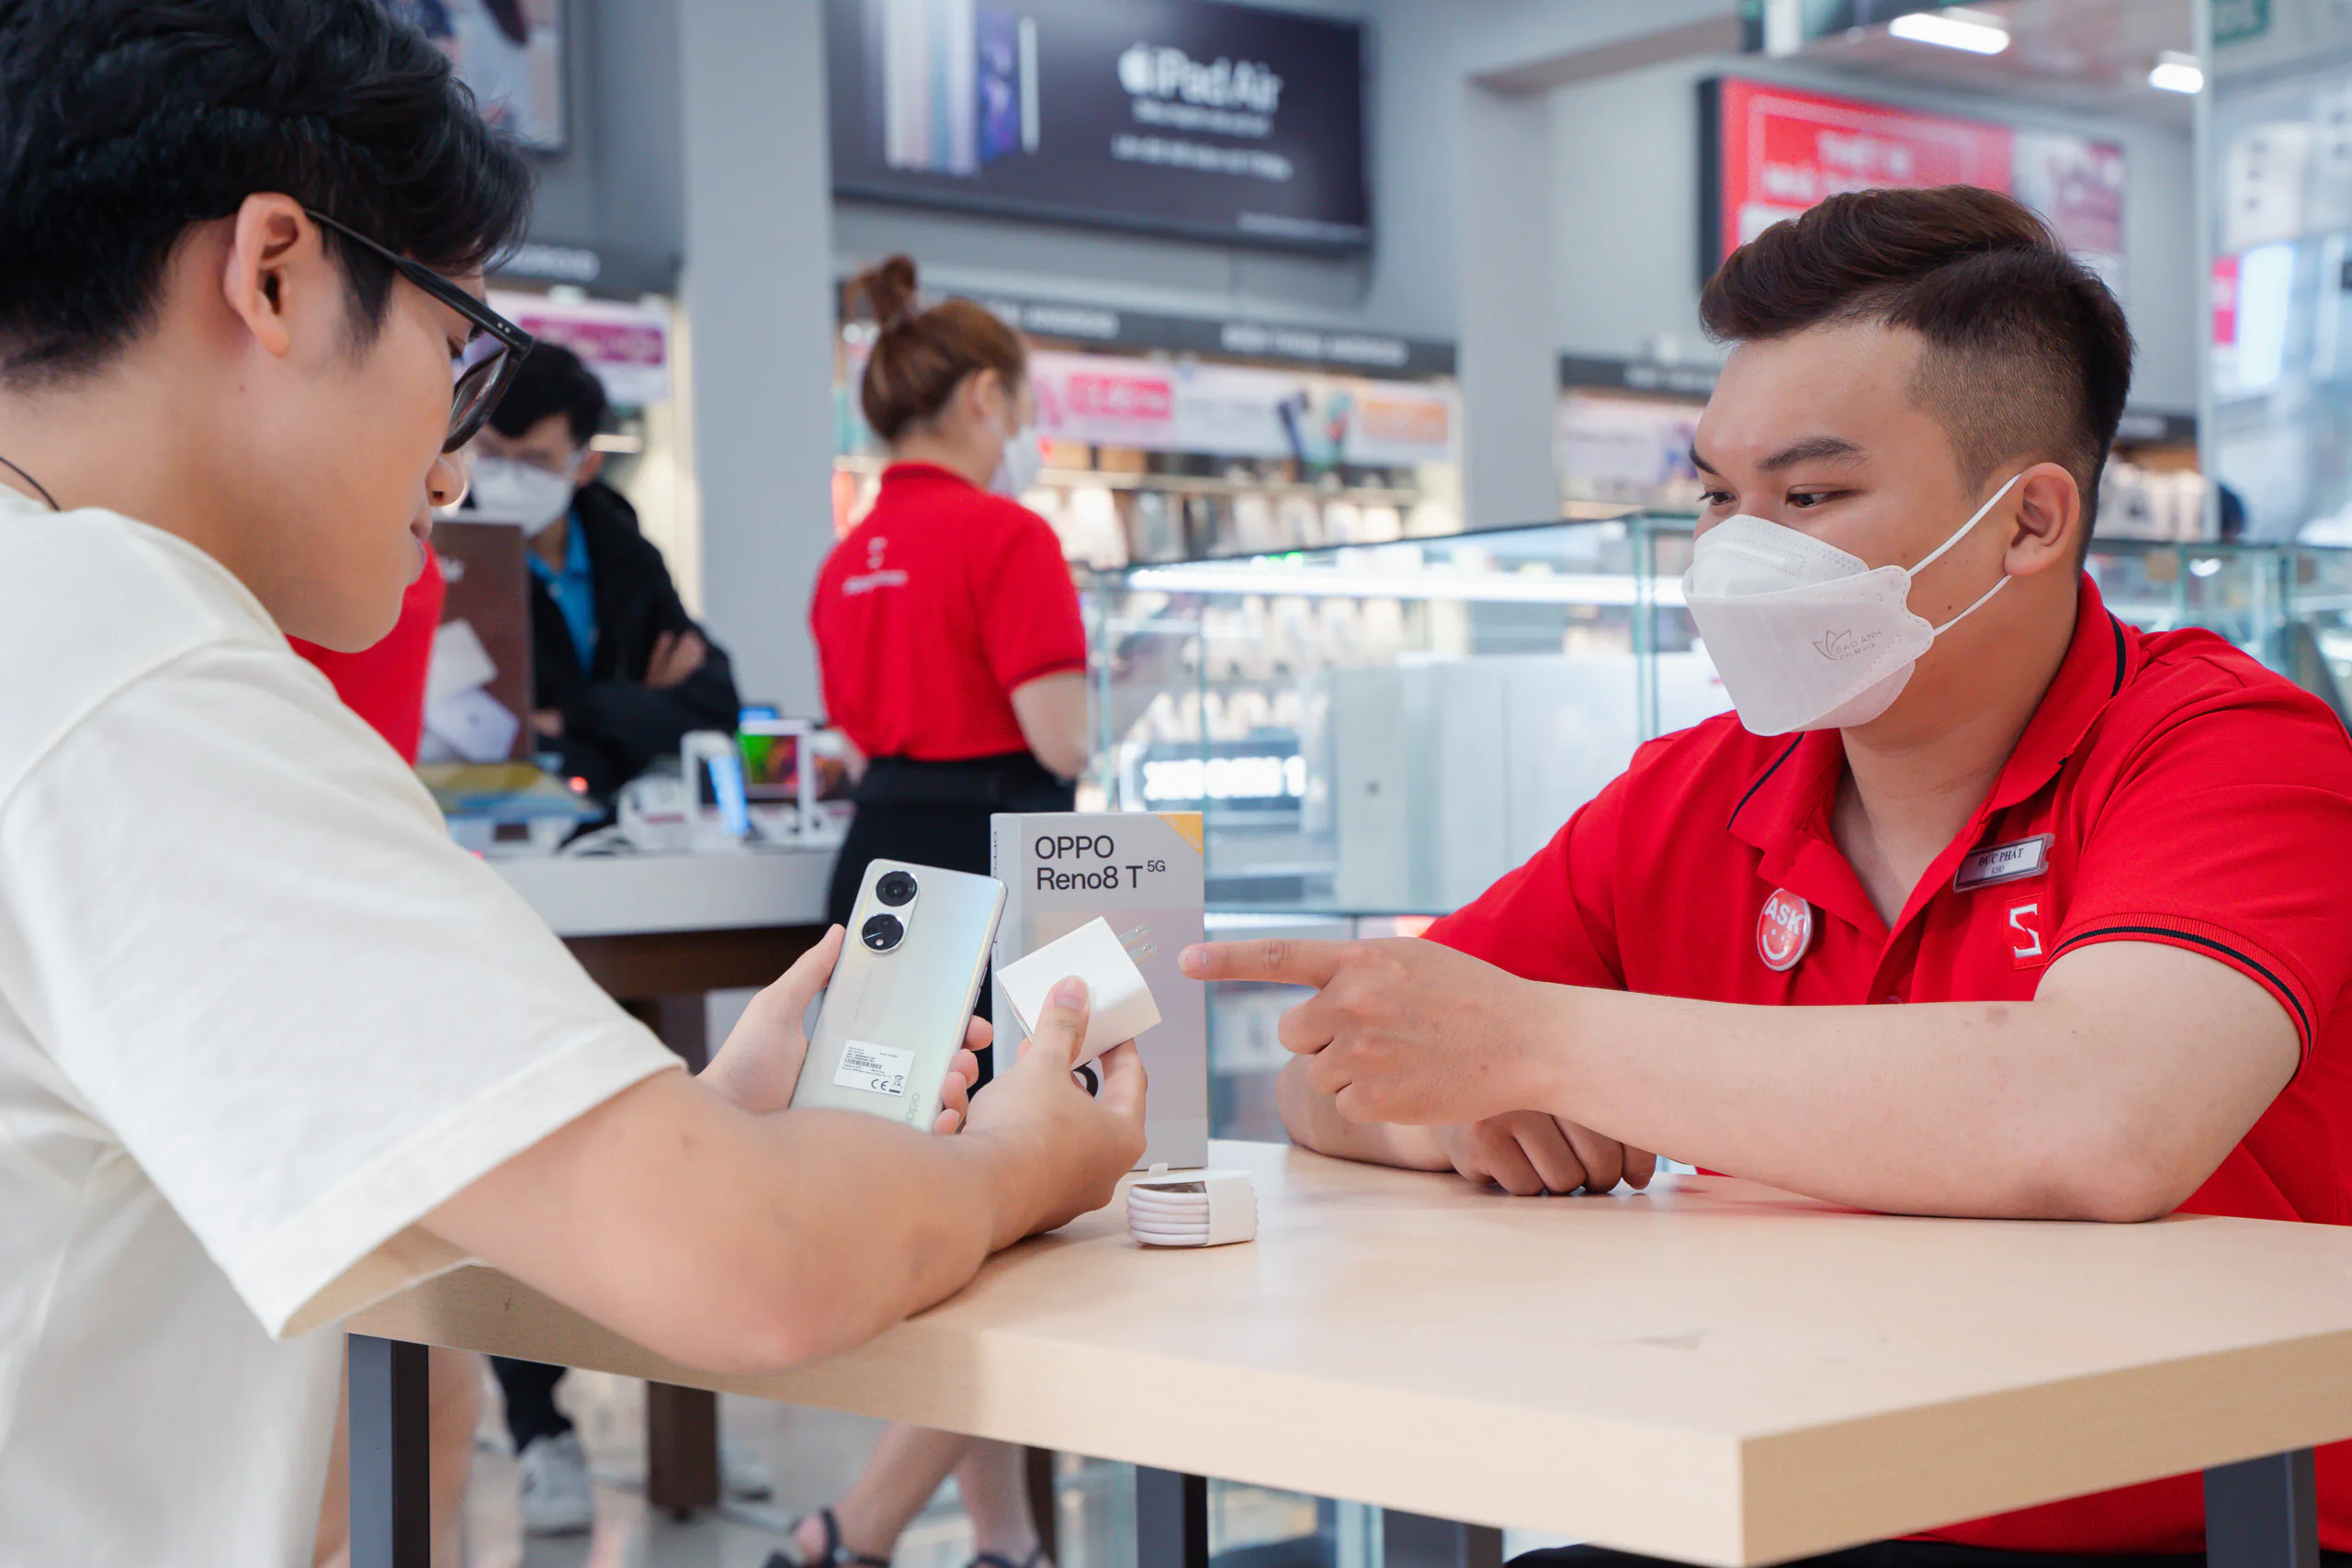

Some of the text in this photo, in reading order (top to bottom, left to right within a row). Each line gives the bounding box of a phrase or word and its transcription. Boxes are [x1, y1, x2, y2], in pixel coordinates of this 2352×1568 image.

[1860, 629, 1883, 644] ANH
[1035, 835, 1114, 860] OPPO
[1036, 865, 1119, 890] Reno8
[1147, 861, 1166, 873] 5G
[1764, 897, 1805, 935] ASK
[906, 1092, 920, 1125] ppo
